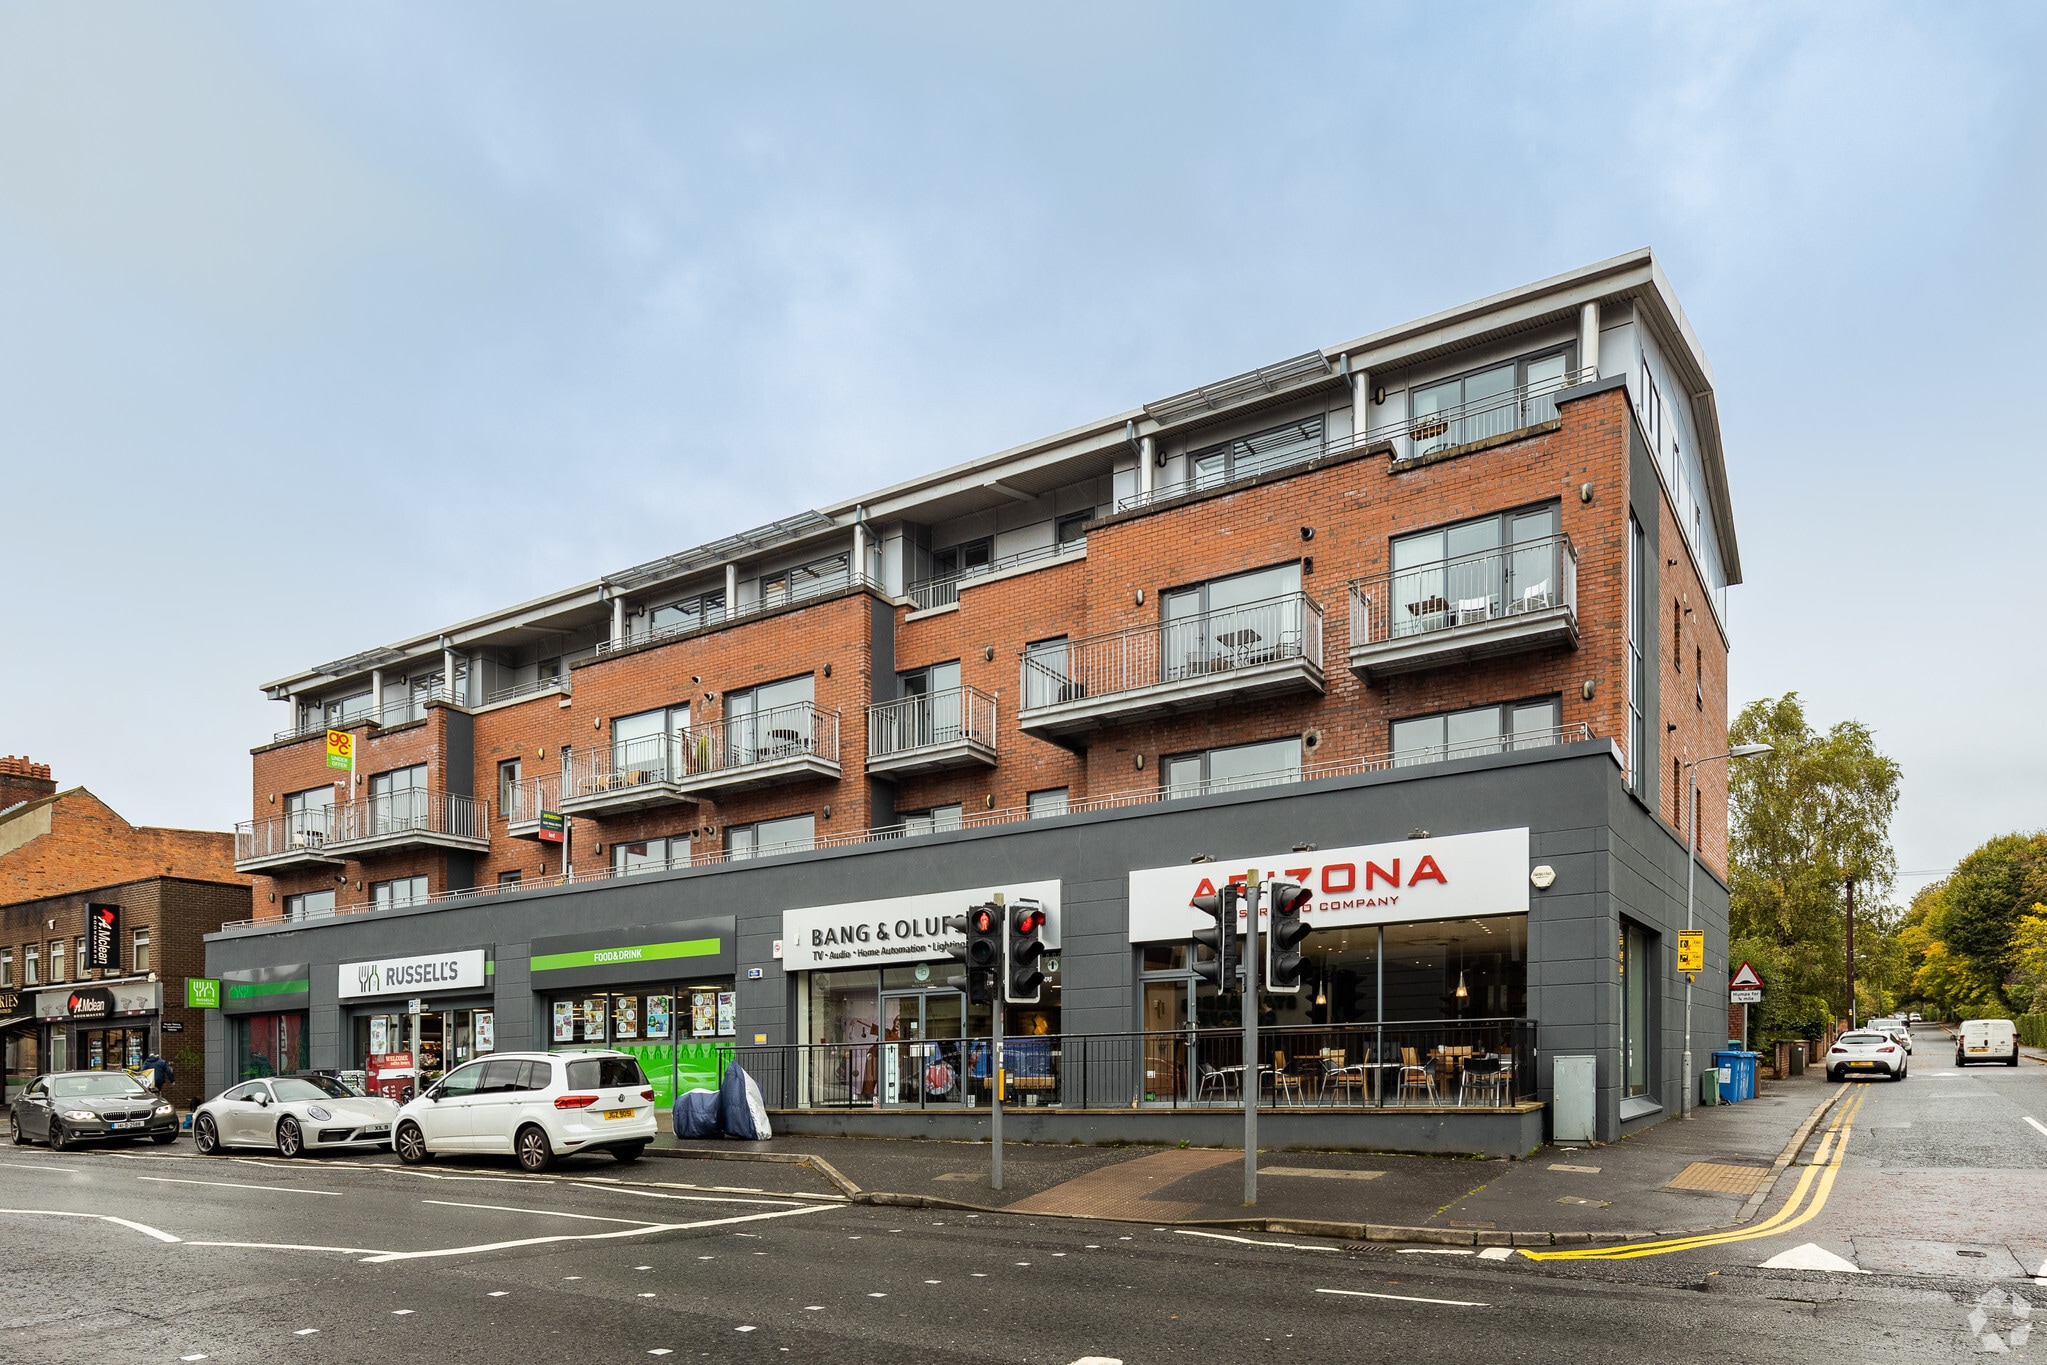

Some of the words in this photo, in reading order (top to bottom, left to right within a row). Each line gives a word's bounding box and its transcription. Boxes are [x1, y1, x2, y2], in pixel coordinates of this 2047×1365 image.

[1189, 855, 1447, 906] AZONA
[1319, 896, 1399, 911] COMPANY
[812, 924, 869, 947] BANG
[877, 922, 890, 940] &
[895, 914, 966, 939] OLUF
[813, 951, 823, 961] TV
[829, 951, 851, 960] Audio
[858, 948, 880, 958] Home
[881, 944, 926, 956] Automation
[386, 961, 458, 986] RUSSELL'S
